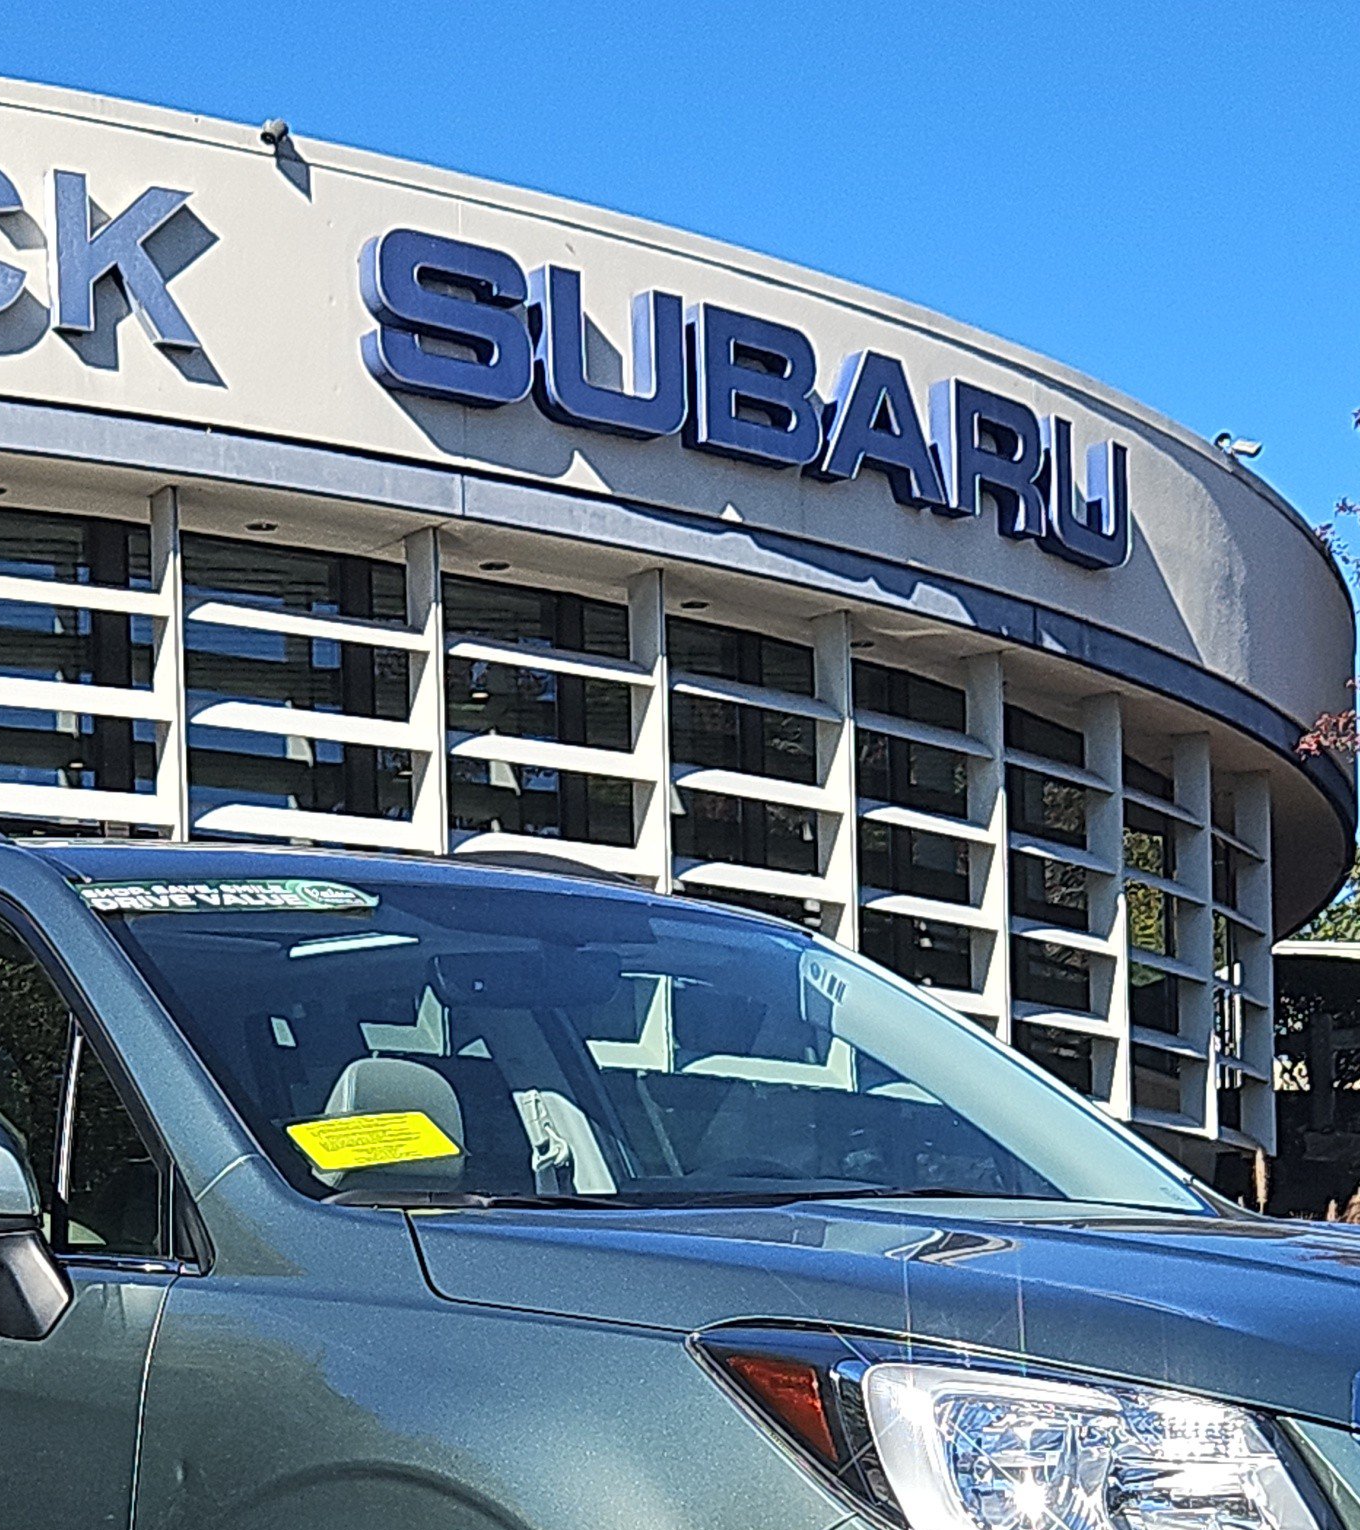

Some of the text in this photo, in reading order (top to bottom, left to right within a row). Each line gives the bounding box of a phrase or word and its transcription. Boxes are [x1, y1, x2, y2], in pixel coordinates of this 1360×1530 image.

[360, 228, 1131, 570] SUBARU
[91, 893, 197, 911] DRIVE
[195, 892, 307, 906] VALUE
